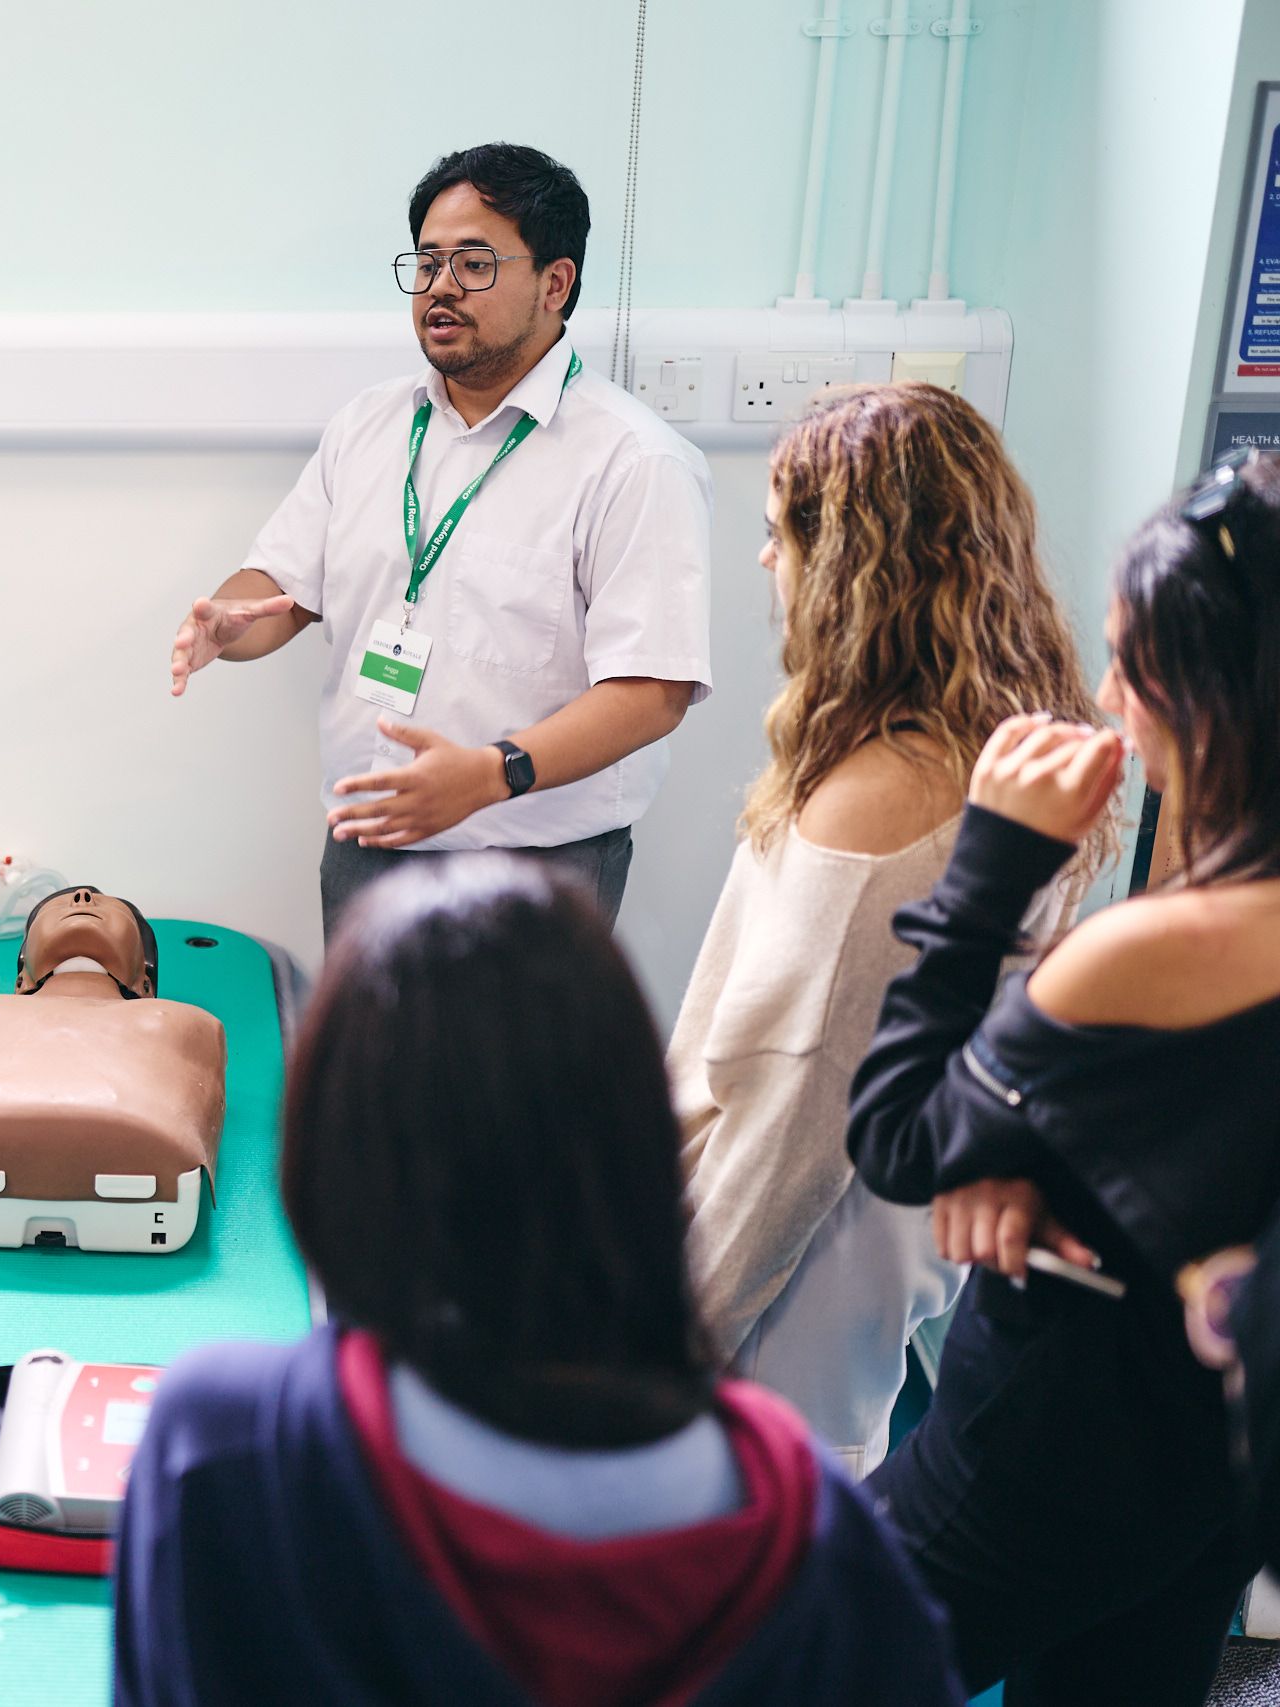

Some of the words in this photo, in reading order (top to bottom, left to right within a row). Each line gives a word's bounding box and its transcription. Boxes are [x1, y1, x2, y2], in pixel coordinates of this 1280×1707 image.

[1231, 435, 1271, 444] HEALTH
[1272, 435, 1280, 444] &
[407, 508, 416, 536] Royale
[419, 544, 438, 571] Oxford
[433, 519, 453, 545] Royale
